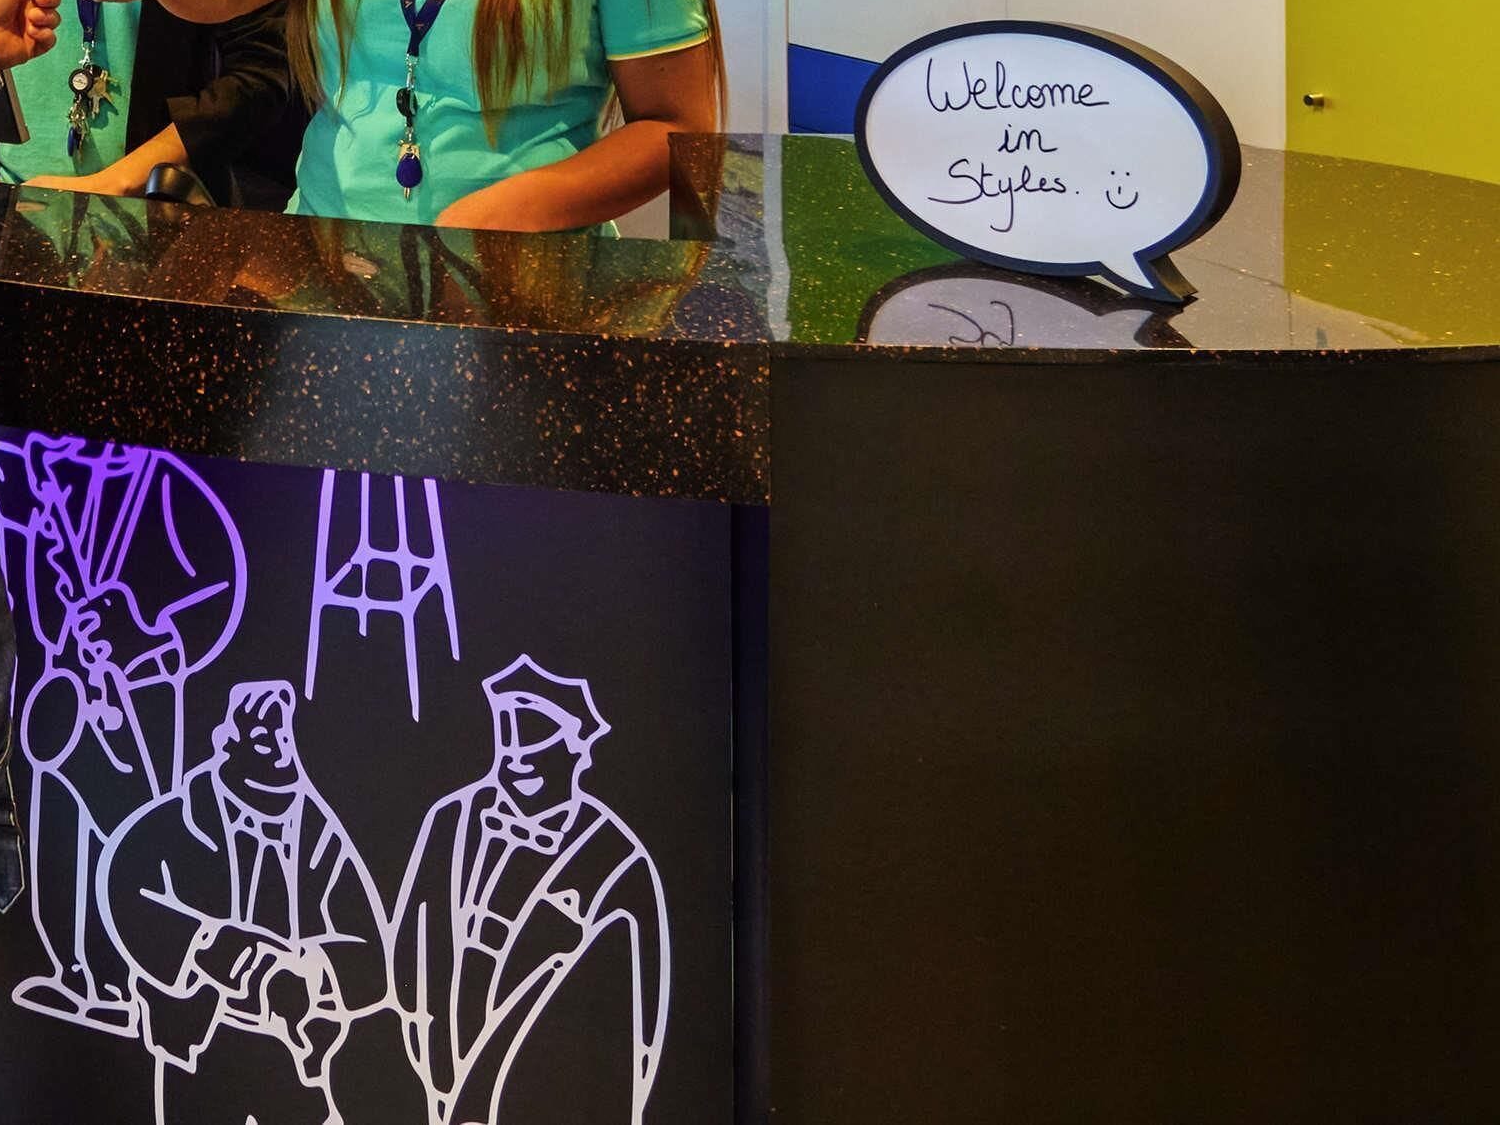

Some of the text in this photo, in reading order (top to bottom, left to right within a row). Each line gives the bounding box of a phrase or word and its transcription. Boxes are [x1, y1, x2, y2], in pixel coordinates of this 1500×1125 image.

[926, 58, 1111, 113] Welcome
[997, 123, 1058, 153] in
[927, 158, 1081, 233] Styles.
